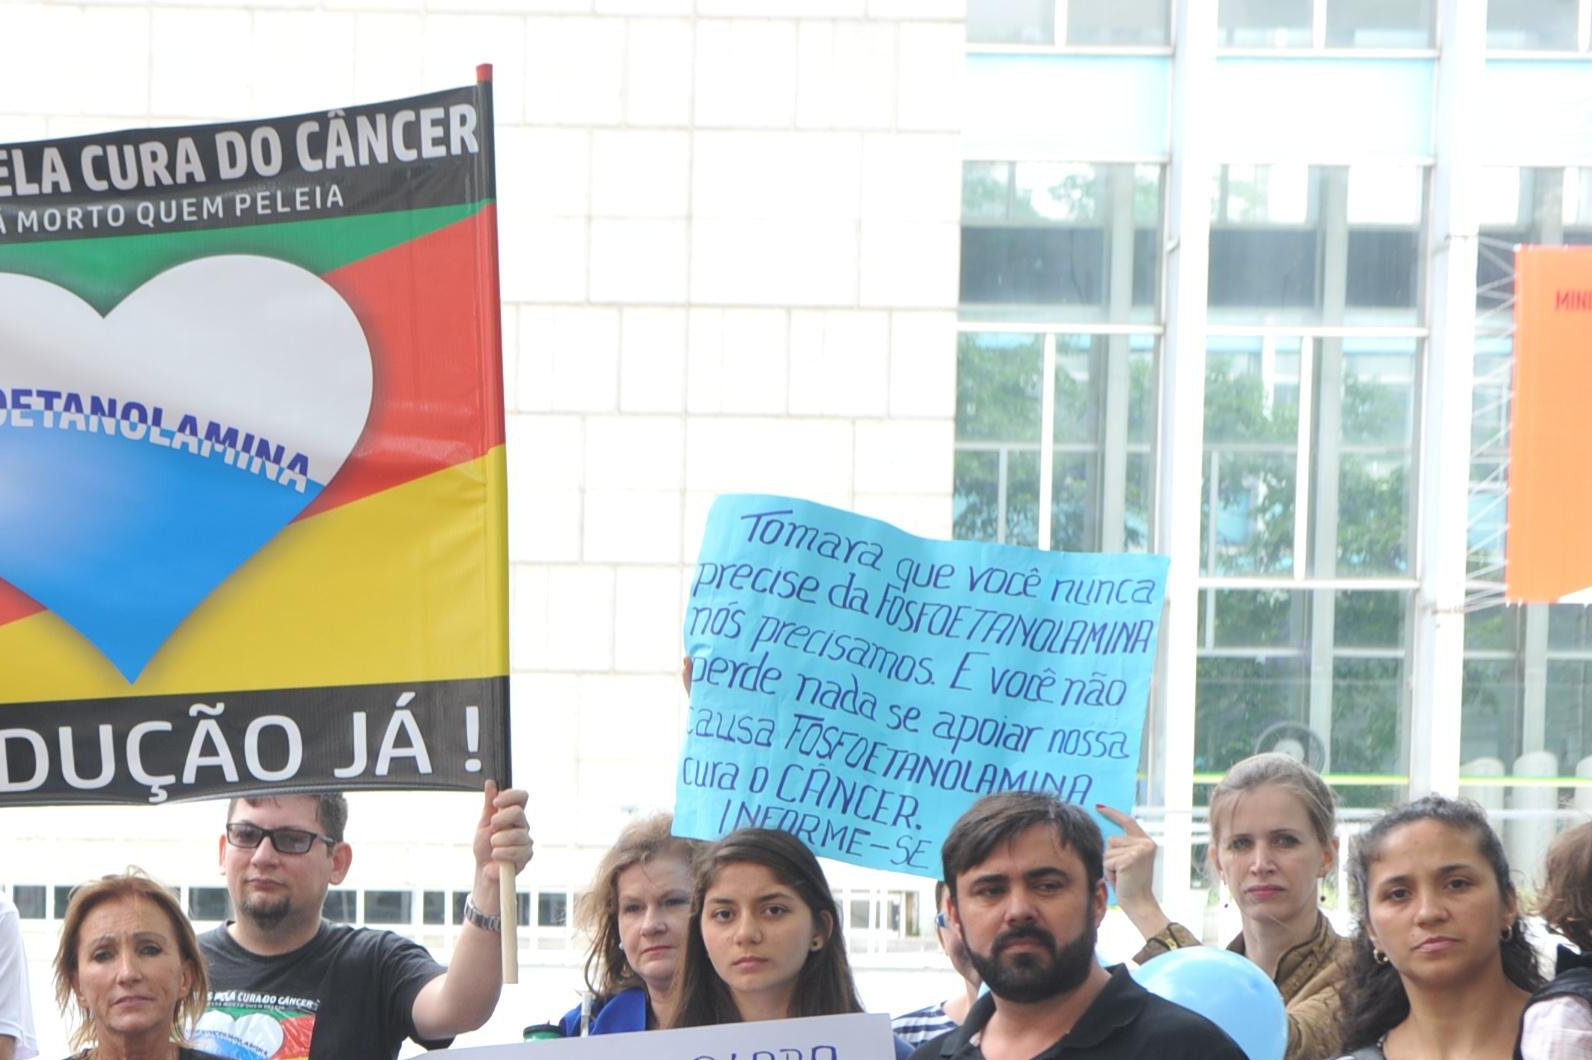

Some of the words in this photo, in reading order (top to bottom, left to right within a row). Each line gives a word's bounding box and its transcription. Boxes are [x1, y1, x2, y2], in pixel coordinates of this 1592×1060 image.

[80, 137, 204, 191] CURA
[216, 126, 282, 180] DO
[296, 103, 480, 171] CÂNCER
[18, 204, 125, 233] MORTO
[137, 197, 225, 229] QUEM
[235, 184, 344, 217] PELEIA
[741, 510, 882, 572] Tomara
[896, 558, 955, 592] que
[969, 567, 1042, 597] você
[1051, 577, 1155, 604] nunca
[691, 601, 742, 639] nós
[751, 614, 936, 686] precisamos.
[951, 651, 990, 691] E
[990, 668, 1056, 701] você
[1060, 673, 1126, 707] não
[692, 561, 819, 600] precise
[829, 574, 869, 611] da
[876, 583, 1153, 655] FOSFOETANOLAMINA
[334, 693, 432, 779] JÁ
[691, 651, 782, 694] perde
[797, 672, 877, 721] nada
[886, 702, 919, 733] se
[932, 710, 1044, 754] apoiar
[1047, 725, 1130, 759] nossa
[683, 756, 739, 791] cura
[775, 761, 922, 830] CÂNCER.
[785, 713, 1093, 806] FOSFOETANOLAMINA
